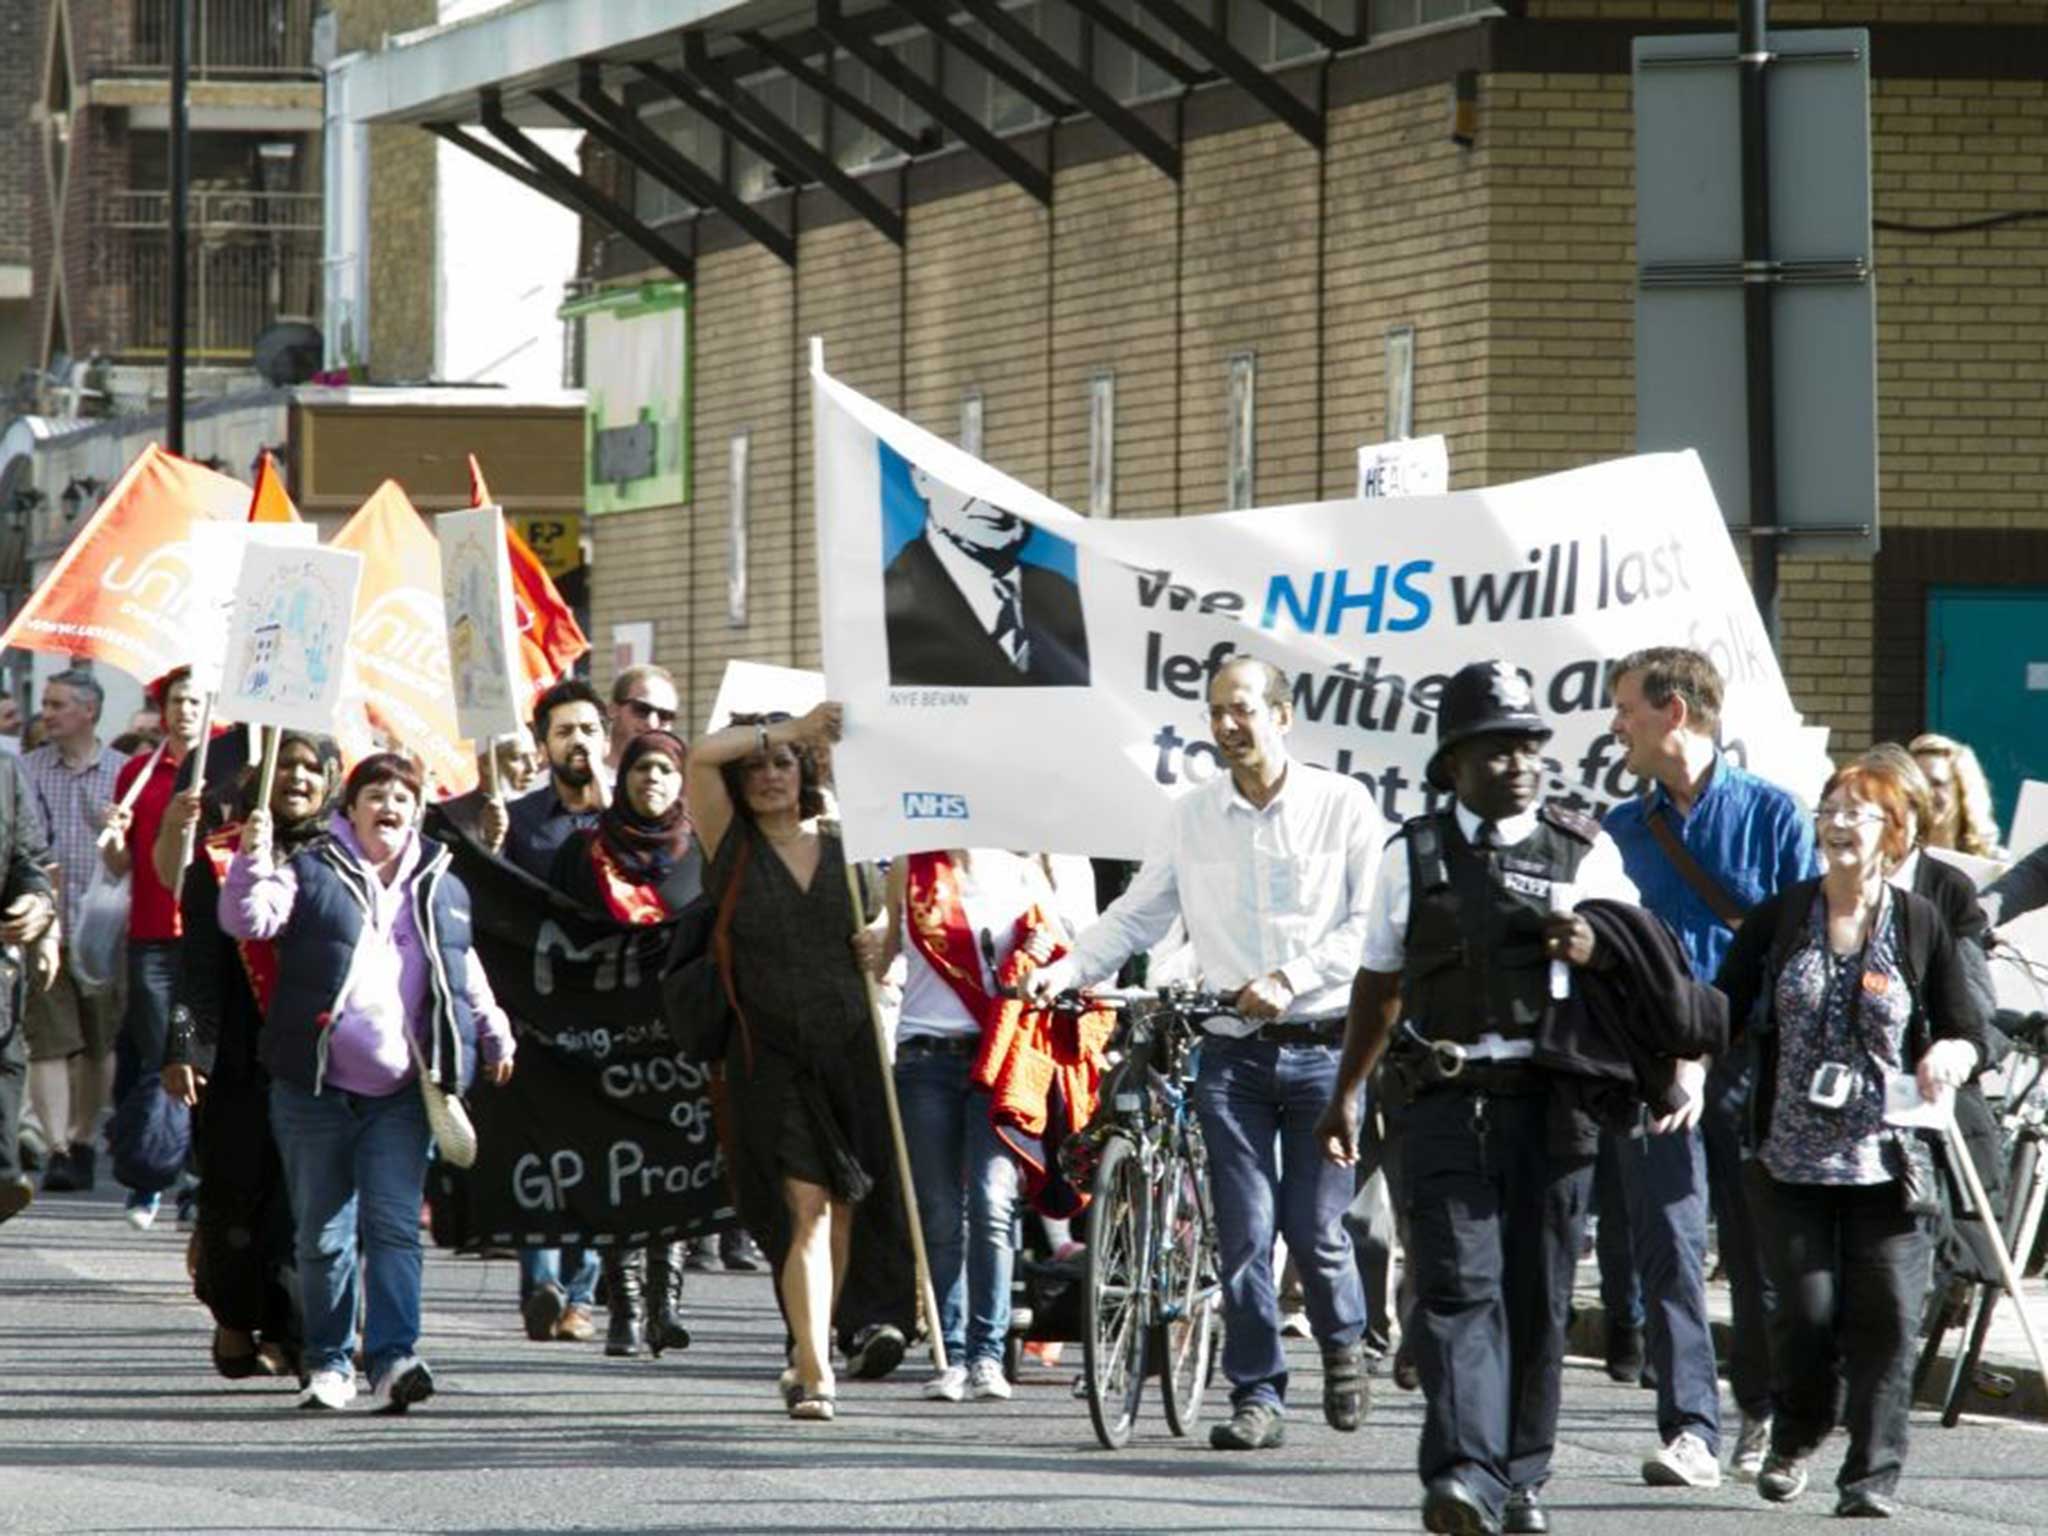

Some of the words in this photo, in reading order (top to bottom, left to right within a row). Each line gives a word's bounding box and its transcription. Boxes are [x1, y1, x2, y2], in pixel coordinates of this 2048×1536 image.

[1261, 558, 1434, 634] NHS
[1450, 540, 1578, 625] will
[1597, 532, 1690, 609] last
[1145, 630, 1236, 702] lef
[905, 793, 967, 817] NHS
[670, 1096, 712, 1144] of
[513, 1149, 584, 1211] GP
